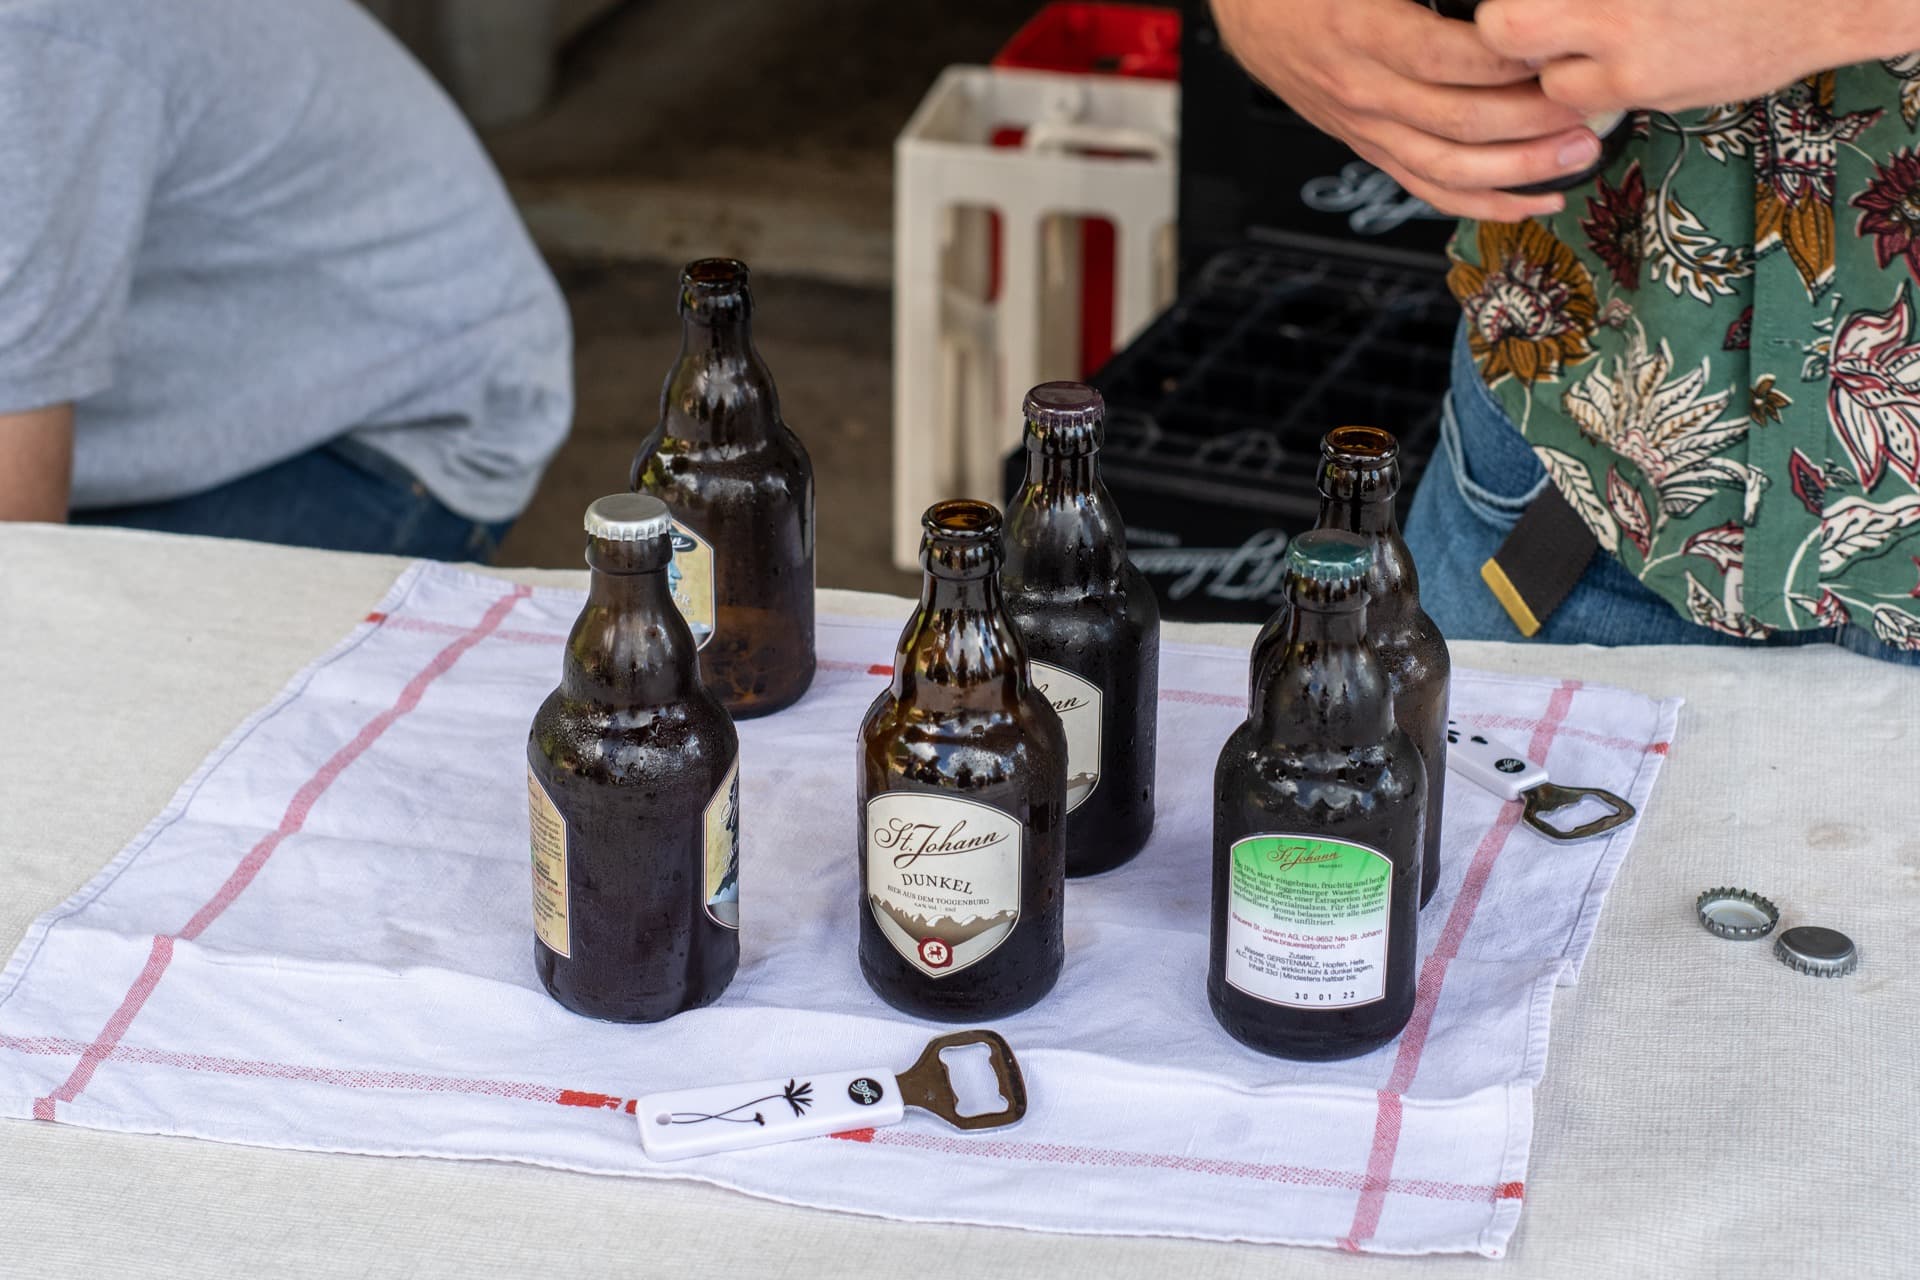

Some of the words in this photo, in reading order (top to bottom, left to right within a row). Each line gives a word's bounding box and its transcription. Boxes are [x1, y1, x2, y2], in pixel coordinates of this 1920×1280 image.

[874, 817, 914, 851] St.
[893, 820, 1010, 869] Johann
[1280, 844, 1344, 872] Johann
[901, 873, 973, 895] DUNKEL
[1259, 879, 1272, 889] mit
[1274, 882, 1329, 897] Toggenburger
[1353, 876, 1369, 887] und
[887, 884, 902, 895] BIER
[902, 890, 917, 900] AUS
[917, 895, 935, 903] DEM
[935, 897, 990, 906] TOGGENBURG
[1294, 896, 1314, 904] einer
[1270, 905, 1296, 915] Aroma
[1297, 910, 1331, 918] belassen
[1346, 909, 1360, 917] alle
[1346, 903, 1360, 911] das
[1273, 912, 1293, 922] Biere
[1294, 918, 1336, 927] unfiltriert.
[1262, 927, 1287, 939] Johann
[1281, 964, 1306, 975] wirklich
[1307, 967, 1322, 976] kühl
[1325, 968, 1330, 976] &
[1330, 967, 1353, 976] dunkel
[1349, 959, 1366, 967] Hefe
[1248, 961, 1264, 974] Inhalt
[1282, 972, 1321, 982] Mindestens
[1322, 974, 1345, 982] haltbar
[1295, 992, 1309, 1001] 30
[1318, 993, 1332, 1001] 01
